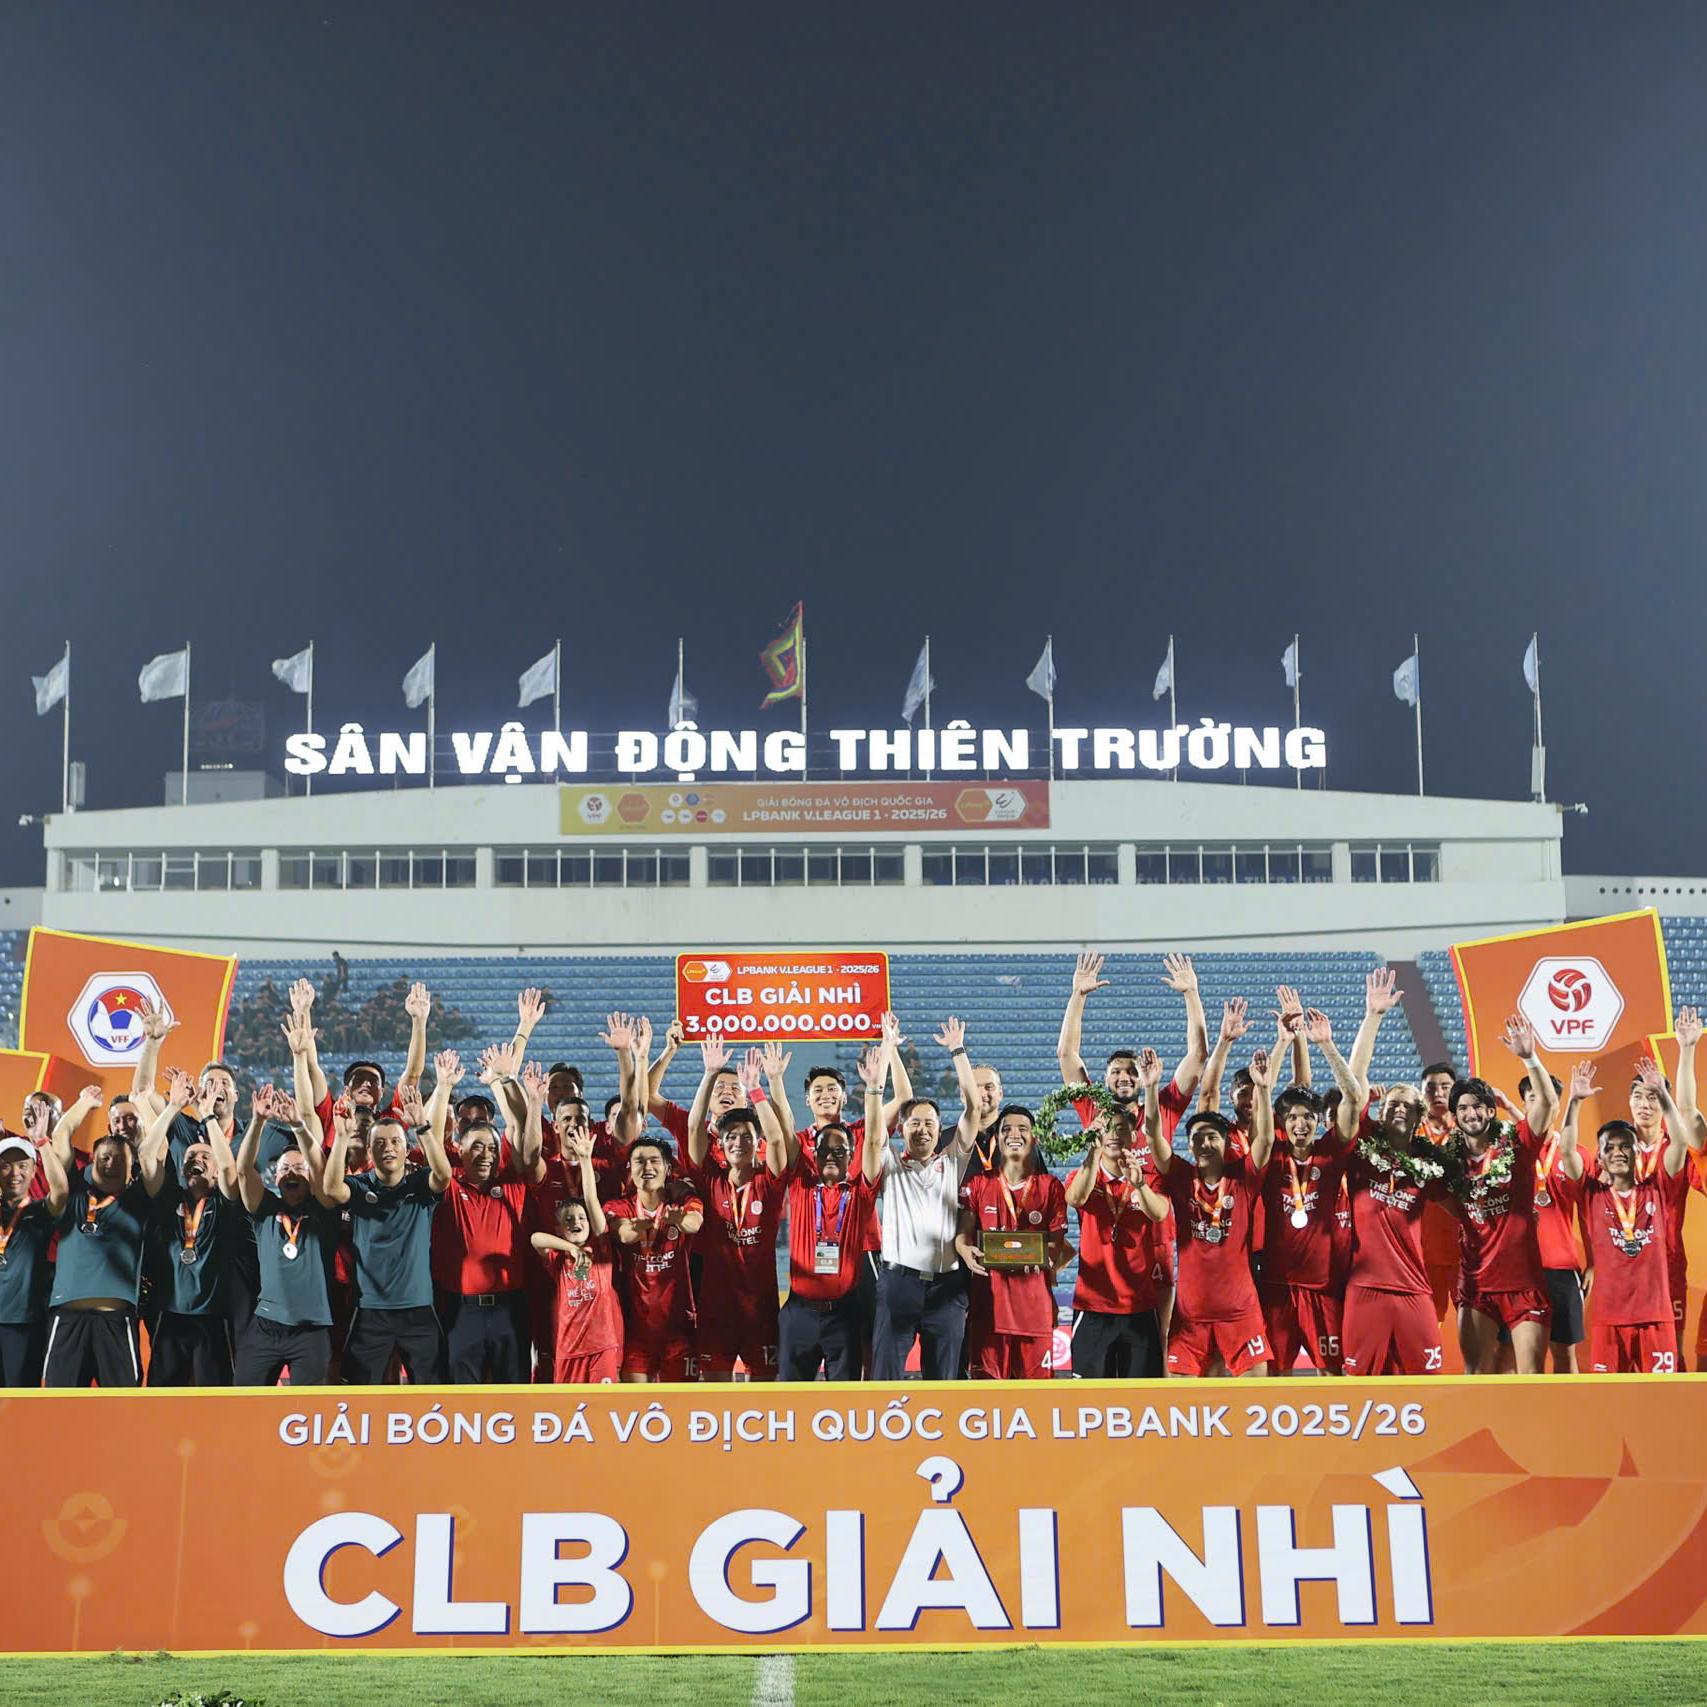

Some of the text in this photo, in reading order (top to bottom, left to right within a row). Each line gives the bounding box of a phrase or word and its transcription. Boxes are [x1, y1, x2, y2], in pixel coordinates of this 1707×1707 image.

[284, 717, 1326, 784] SÂN VẬN ĐỘNG THIÊN TRƯỜNG
[915, 796, 934, 806] GIA
[743, 810, 801, 822] LPBANK
[803, 809, 871, 821] V.LEAGUE
[873, 809, 882, 820] 1
[891, 807, 948, 820] 2025/26
[736, 965, 778, 975] LPBANK
[779, 965, 827, 975] V.LEAGUE
[828, 965, 834, 974] 1
[840, 964, 880, 974] 2025/26
[705, 980, 861, 1005] CLB GIẢI NHÌ
[685, 1013, 871, 1033] 3.000.000.000
[1550, 1018, 1595, 1035] VPF
[111, 1034, 130, 1044] VFF
[1318, 1334, 1340, 1357] 66
[1040, 1349, 1053, 1370] 4
[1424, 1346, 1442, 1370] 25
[1651, 1351, 1675, 1373] 29
[278, 1395, 1427, 1451] GIẢI BÓNG ĐÁ VÔ ĐỊCH QUỐC GIA LPBANK 2025/26
[283, 1455, 1435, 1638] CLB GIẢI NHÌ
